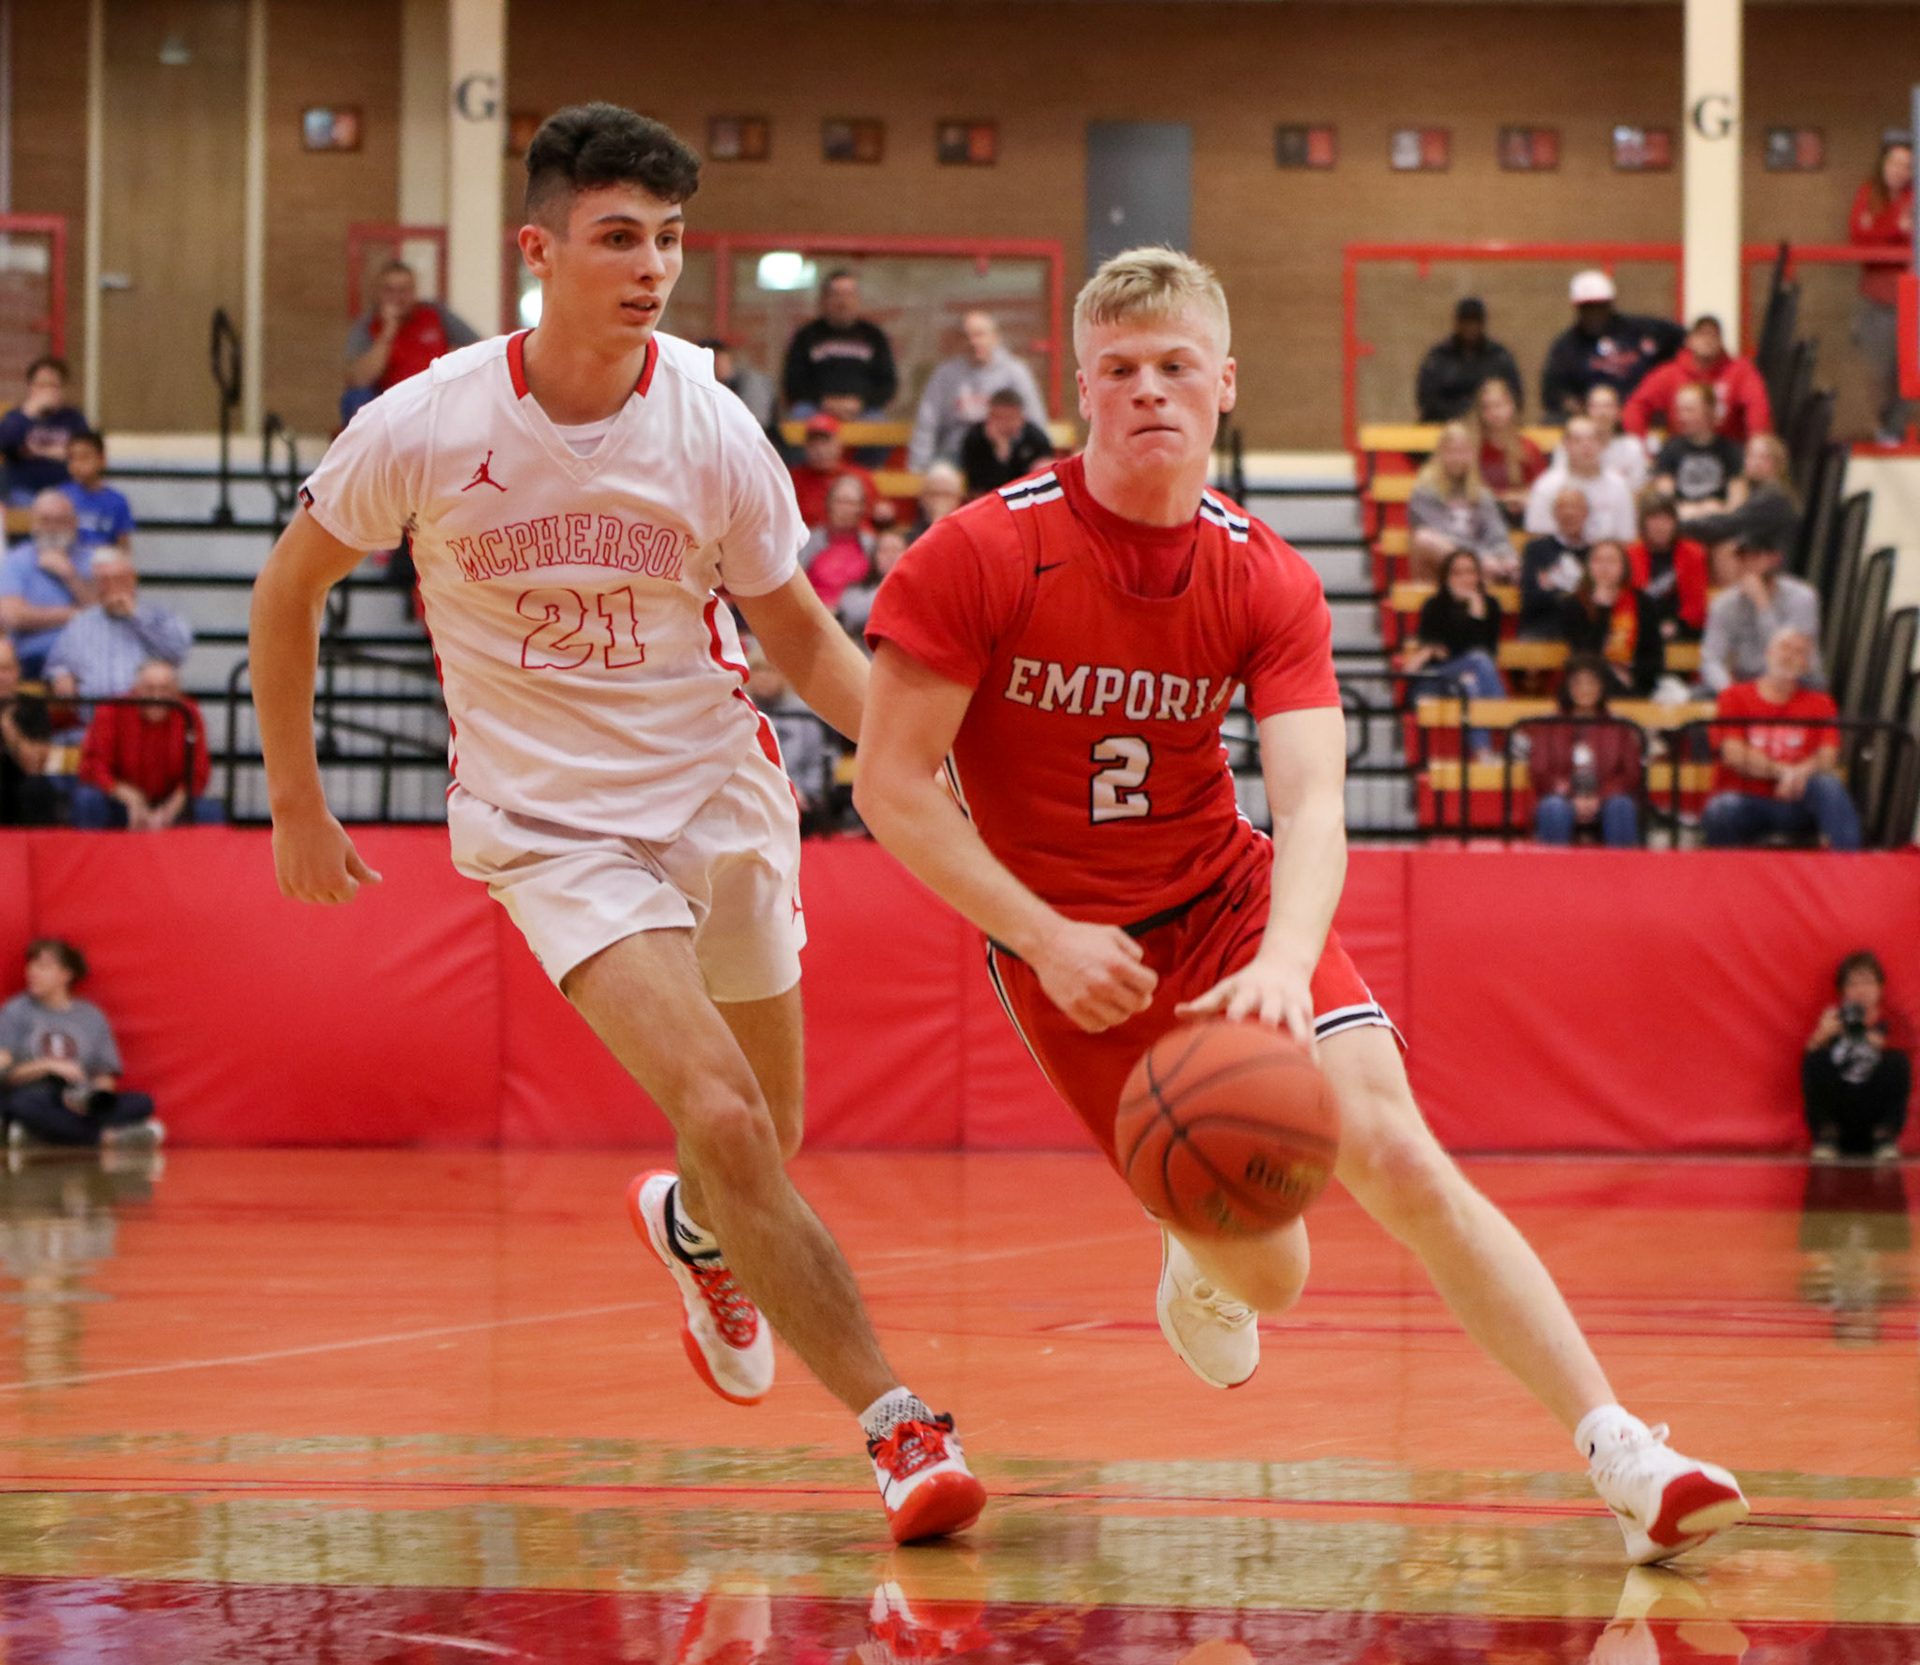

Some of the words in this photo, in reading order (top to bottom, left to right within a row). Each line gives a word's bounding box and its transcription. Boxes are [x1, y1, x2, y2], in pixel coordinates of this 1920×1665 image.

[457, 74, 499, 122] G
[1693, 93, 1737, 140] G
[516, 586, 645, 669] 21
[1089, 735, 1152, 826] 2
